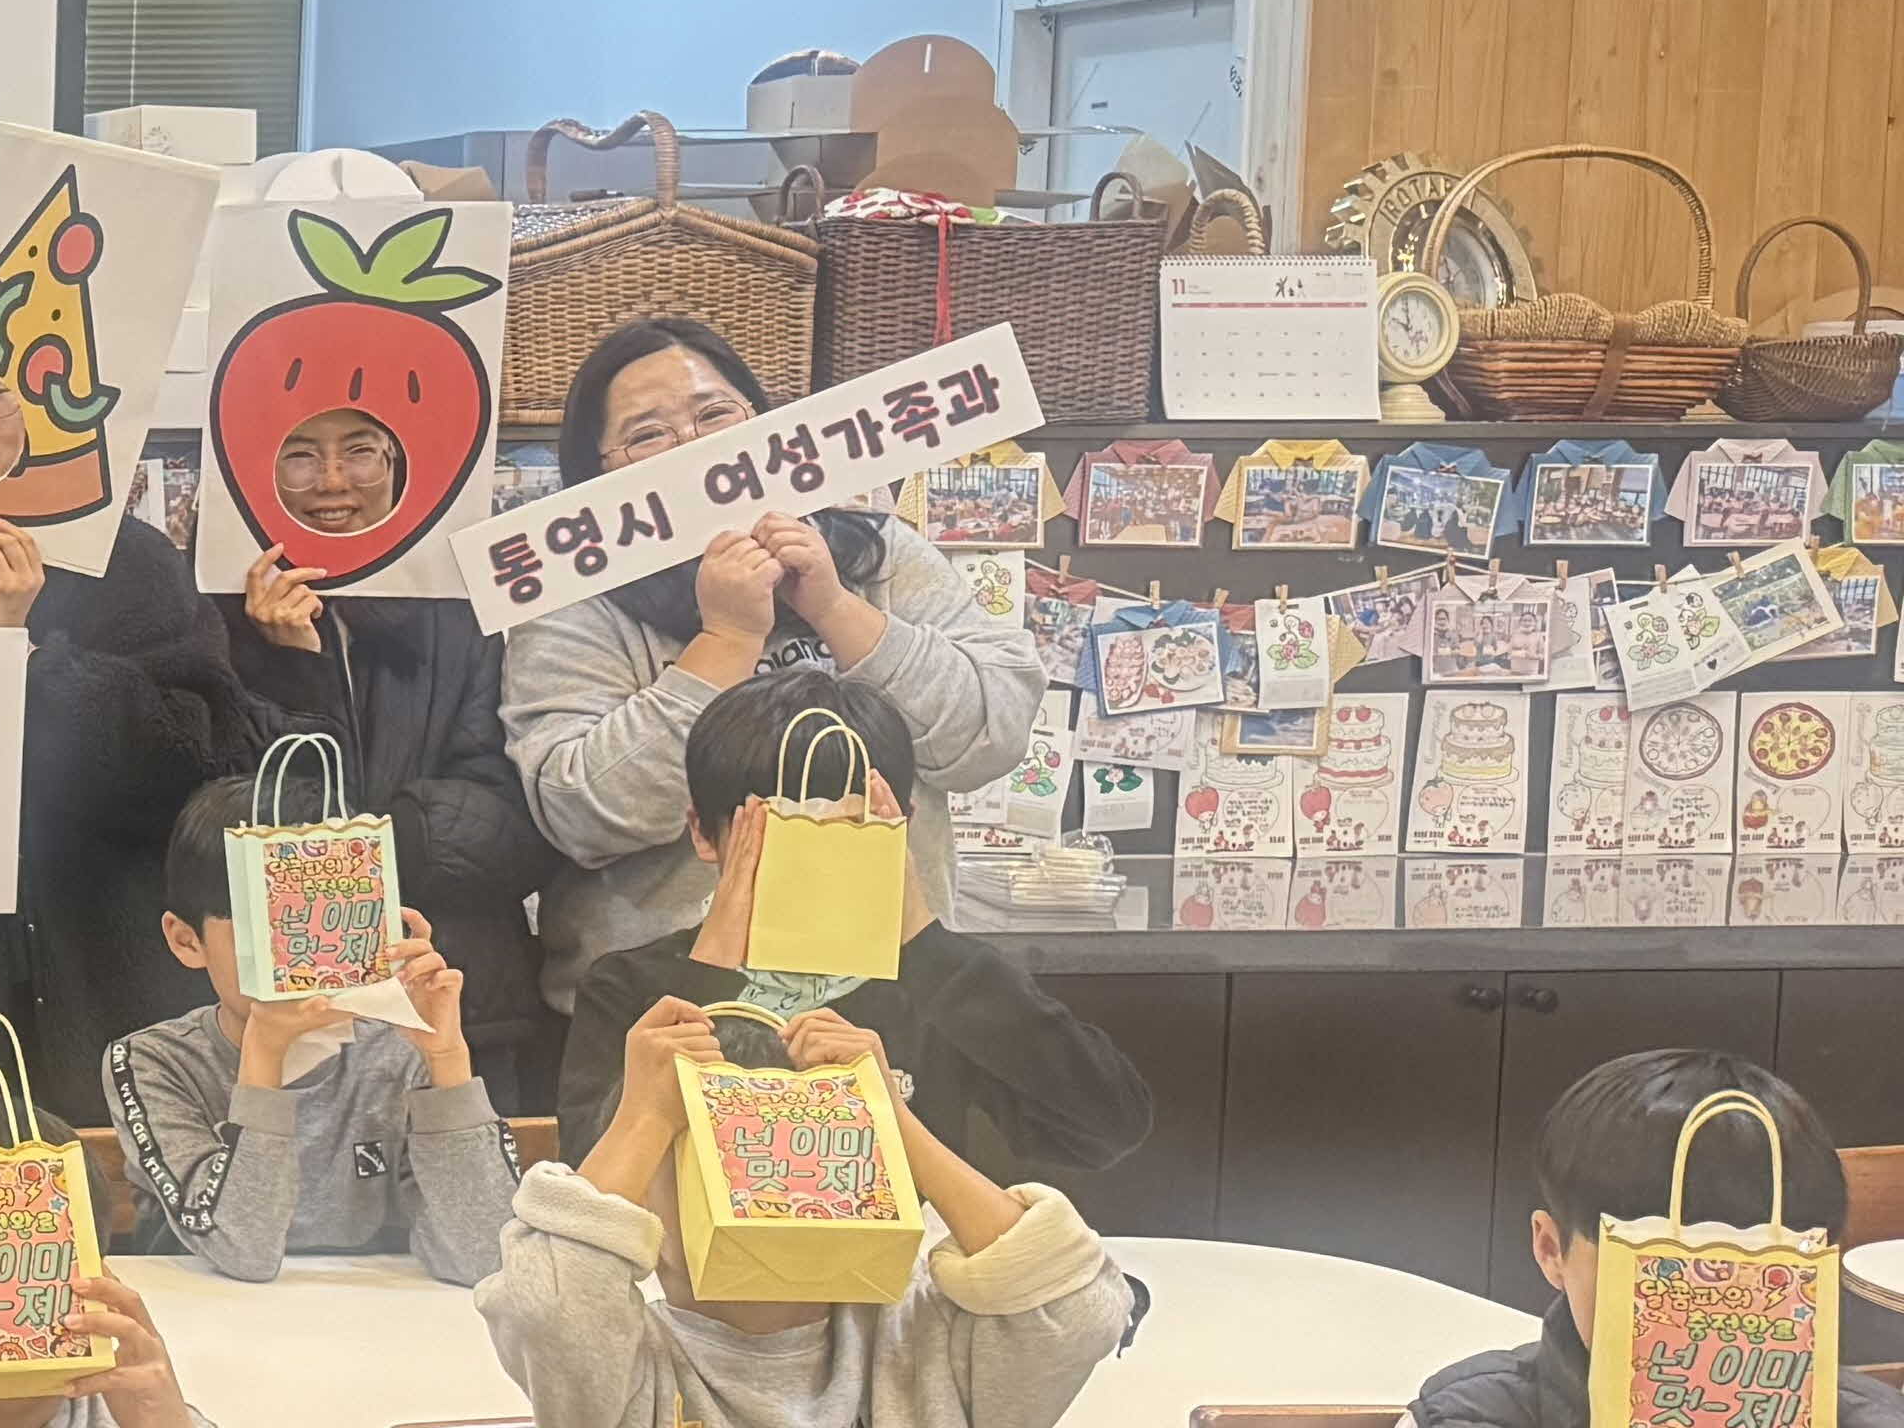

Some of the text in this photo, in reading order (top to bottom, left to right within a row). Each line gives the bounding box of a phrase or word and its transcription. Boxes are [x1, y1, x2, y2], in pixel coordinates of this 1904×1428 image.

[1381, 177, 1455, 227] ROTAR
[1171, 278, 1186, 295] 11
[489, 362, 1000, 605] 통영시 여성가족과
[281, 898, 384, 936] 넌 이미
[735, 1124, 874, 1160] 넌 이미
[1638, 1278, 1752, 1310] 달콤파워
[1687, 1307, 1797, 1343] 충전완료
[1648, 1341, 1812, 1392] 넌 이미
